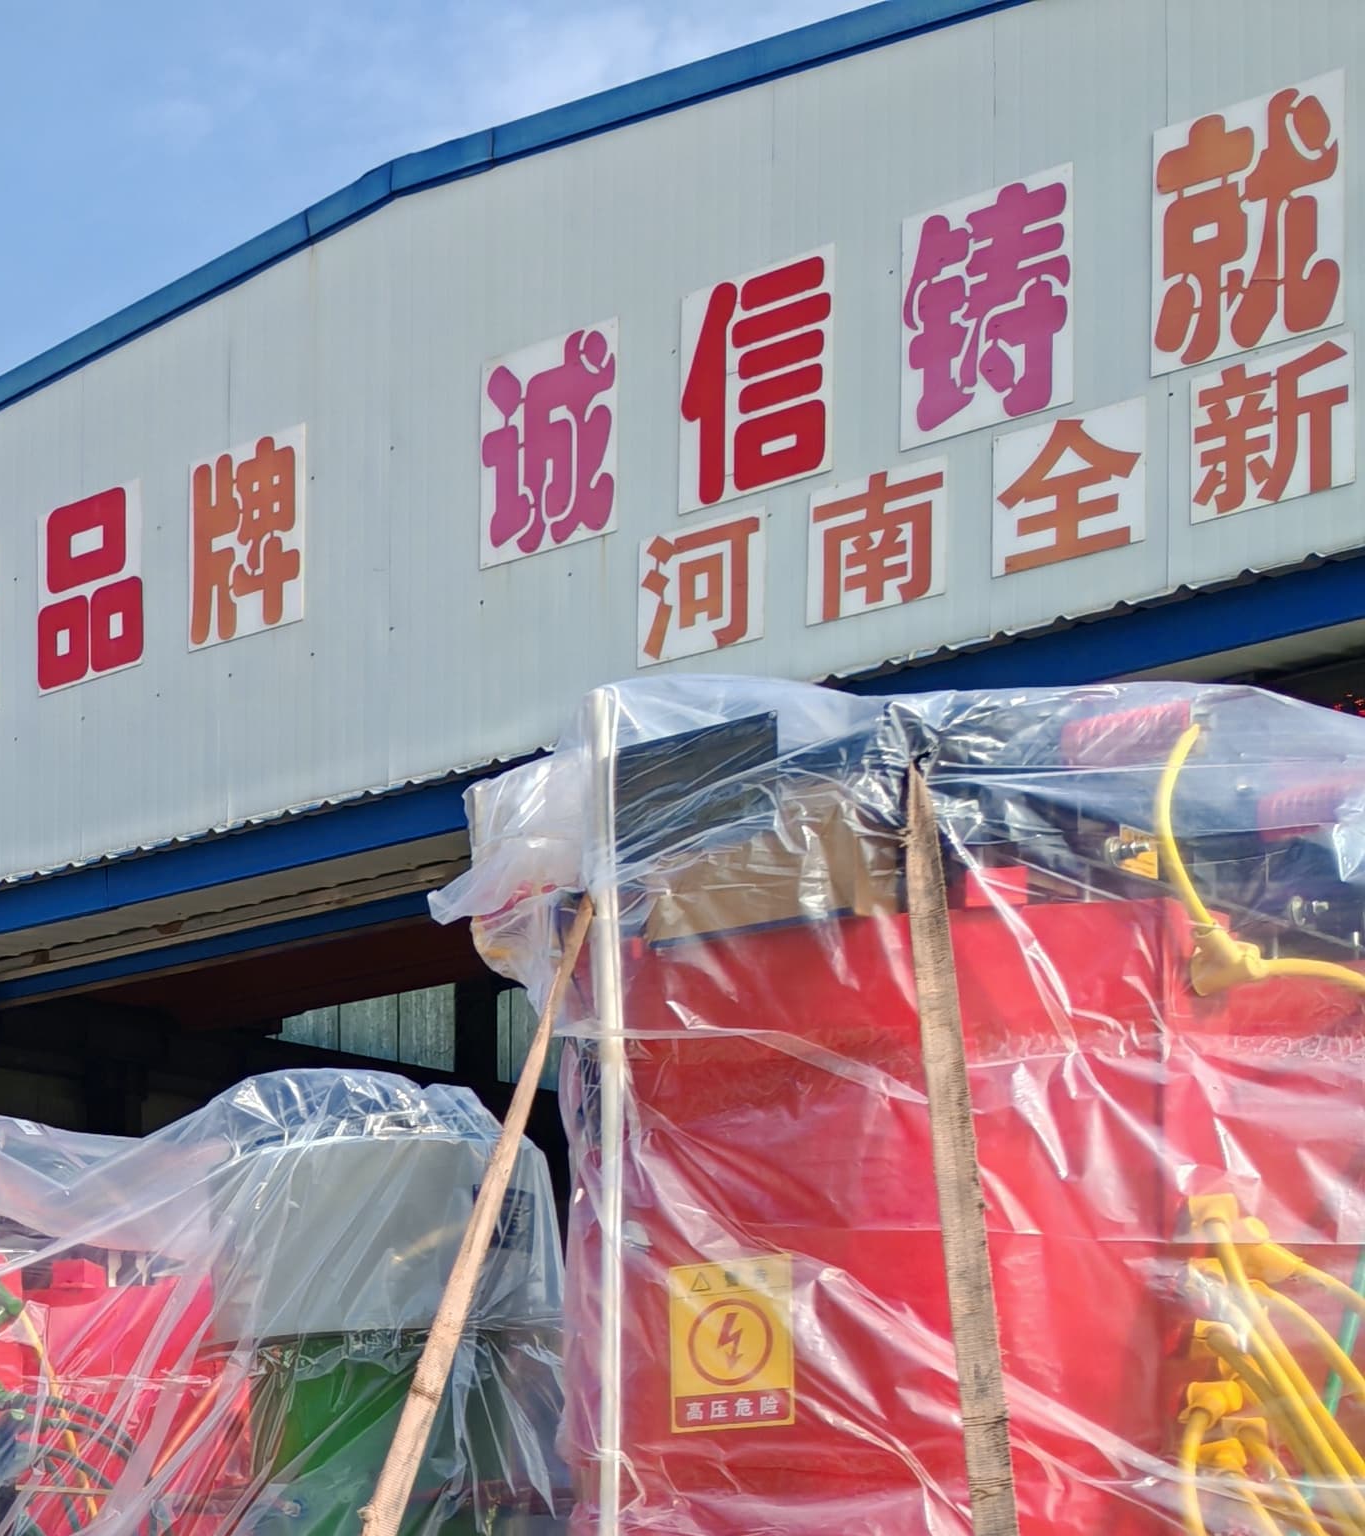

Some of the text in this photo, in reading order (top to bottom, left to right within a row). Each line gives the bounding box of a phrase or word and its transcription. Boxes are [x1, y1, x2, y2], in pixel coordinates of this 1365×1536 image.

[481, 88, 1341, 553] 诚信铸就
[640, 341, 1350, 660] 河南全新
[685, 1396, 780, 1422] 高压危险
